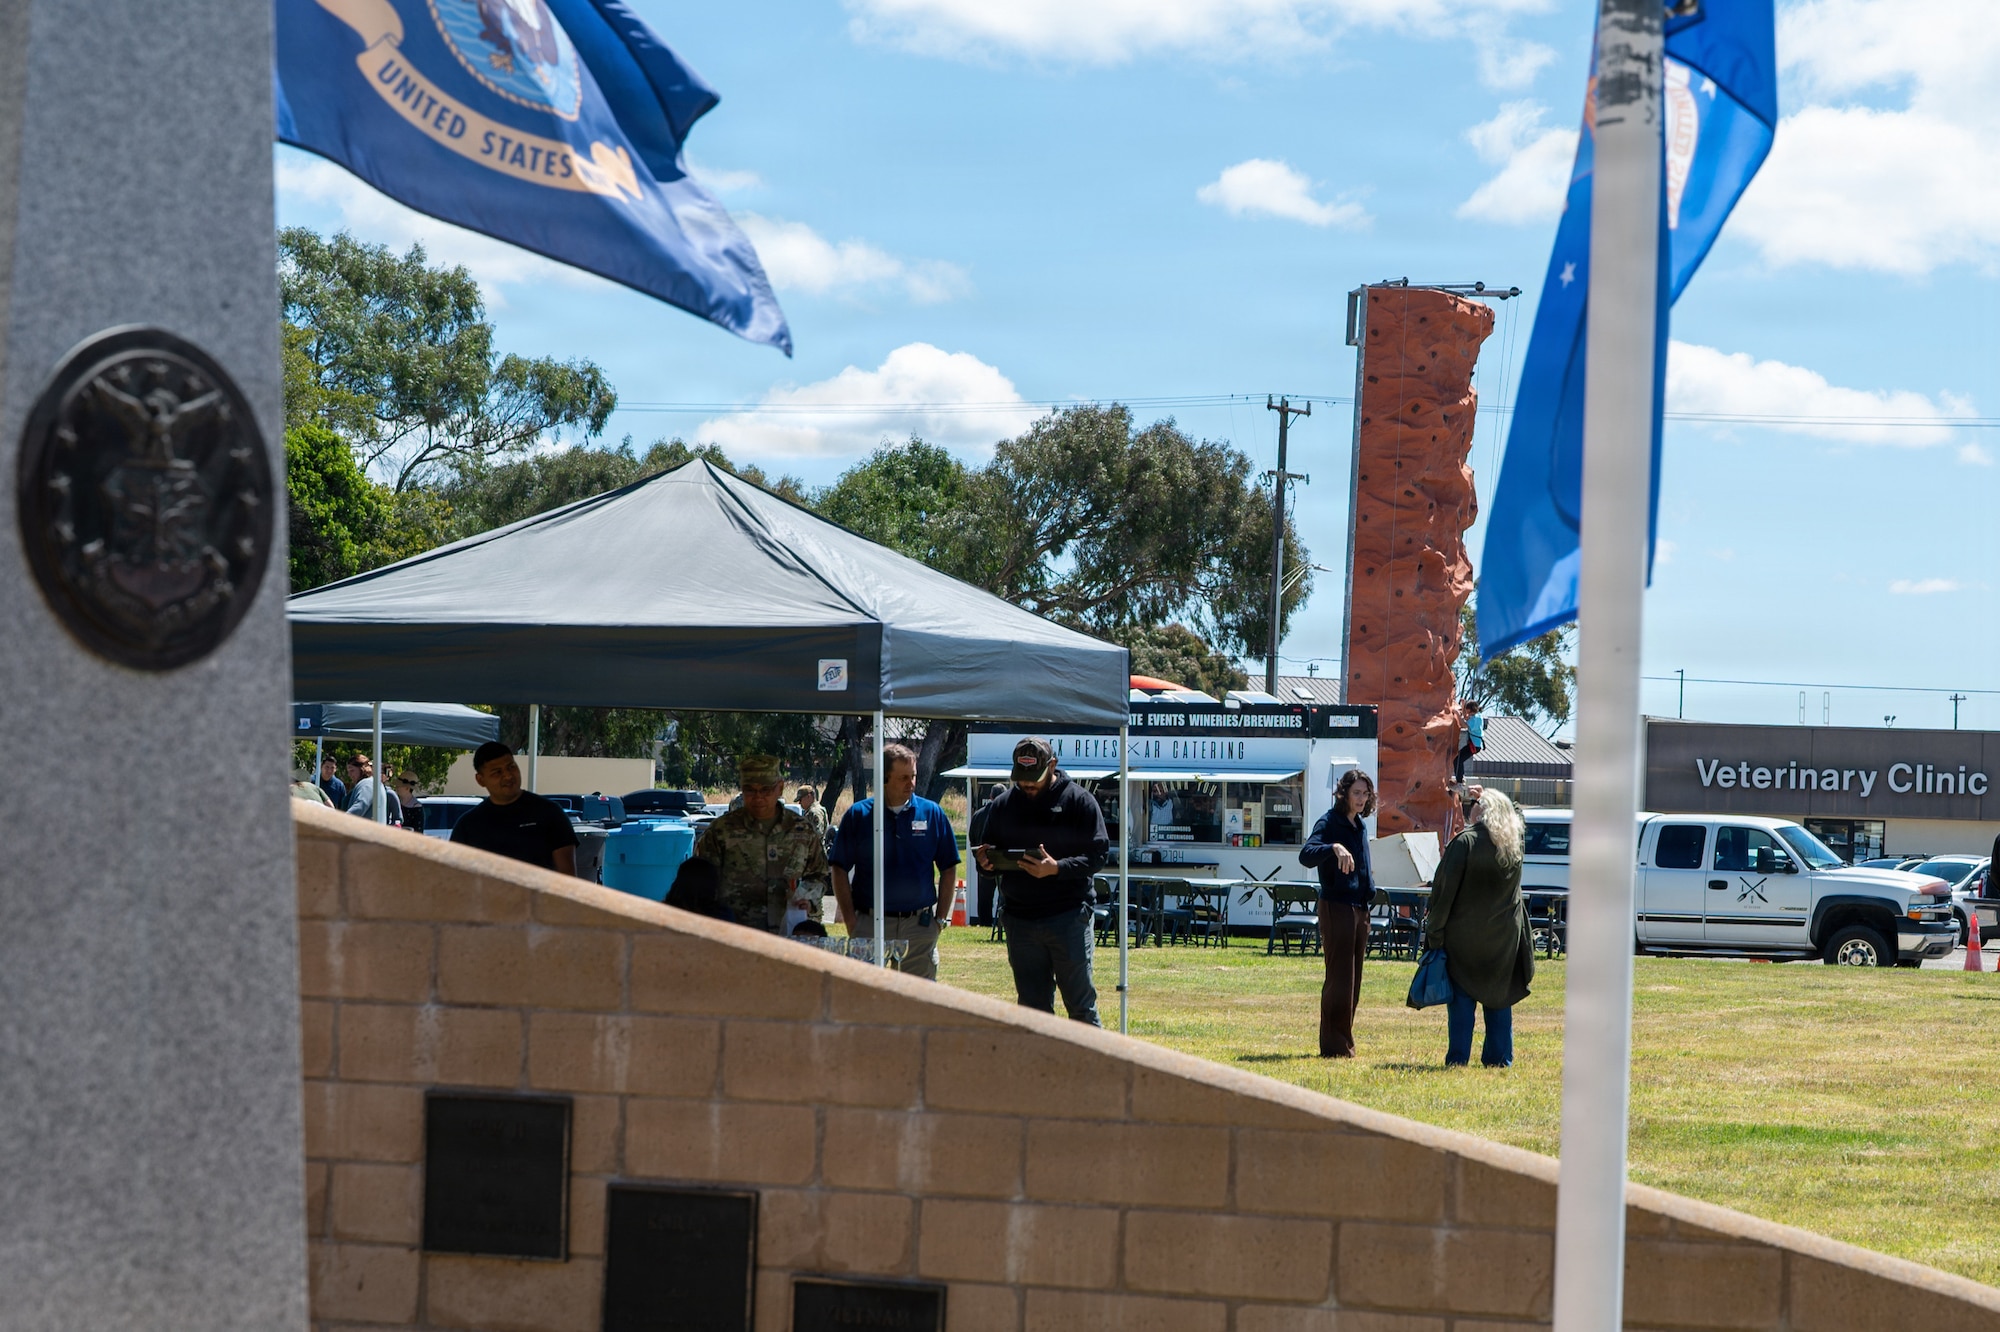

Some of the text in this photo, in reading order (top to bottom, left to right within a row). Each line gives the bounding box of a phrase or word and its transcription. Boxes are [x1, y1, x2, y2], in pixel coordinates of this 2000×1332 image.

[377, 59, 573, 179] UNITED STATES
[1148, 713, 1185, 727] EVENTS
[1189, 713, 1302, 729] WINERIES/BREWERIES
[1075, 738, 1118, 758] REYES
[1145, 741, 1160, 758] AR
[1172, 741, 1244, 760] CATERING
[1696, 758, 1988, 798] Veterinary Clinic
[1154, 781, 1218, 797] THANK YOU
[1273, 804, 1293, 812] ORDER
[1230, 814, 1238, 824] A
